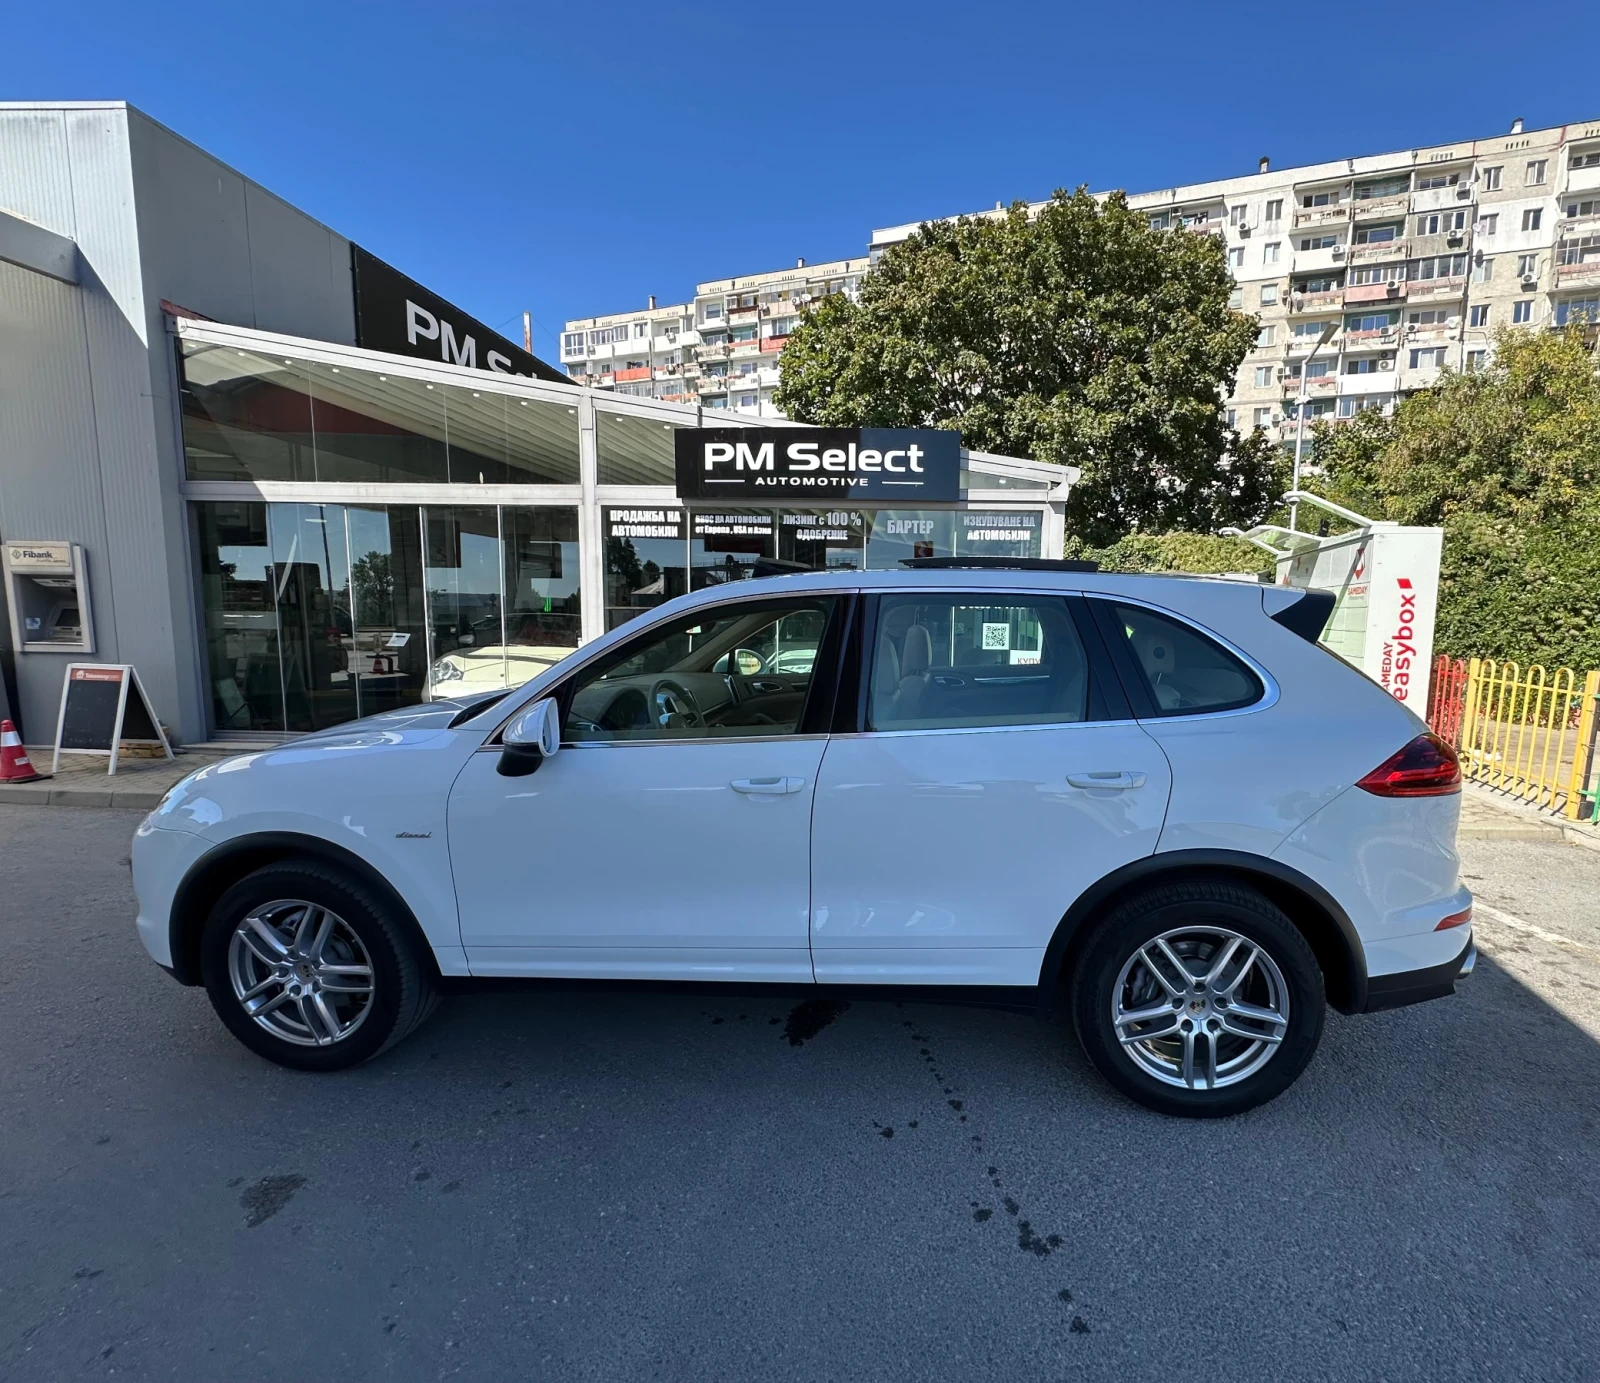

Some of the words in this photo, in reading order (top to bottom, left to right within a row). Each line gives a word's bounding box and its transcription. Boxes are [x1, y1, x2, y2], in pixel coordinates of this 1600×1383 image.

[406, 299, 477, 369] PM
[704, 443, 775, 471] PM
[786, 443, 924, 473] Select
[755, 477, 869, 487] AUTOMOTIVE
[609, 509, 666, 524] ПРОДАЖБА
[666, 510, 682, 523] НА
[714, 514, 725, 524] НА
[724, 515, 772, 524] АВТОМОБИЛИ
[782, 514, 818, 525] ЛИЗИНГ
[825, 512, 849, 526] 100
[963, 515, 1022, 527] ИЗКУПУВАНЕ
[1022, 516, 1036, 527] НА
[611, 524, 679, 538] АВТОМОБИЛИ
[694, 525, 705, 534] от
[887, 519, 934, 534] БАРТЕР
[796, 528, 848, 541] ОДОБРЕНИЕ
[966, 529, 1031, 541] АВТОМОБИЛИ
[23, 550, 53, 559] Fibank
[1392, 594, 1416, 701] easybox
[1381, 641, 1393, 691] AMEDAY
